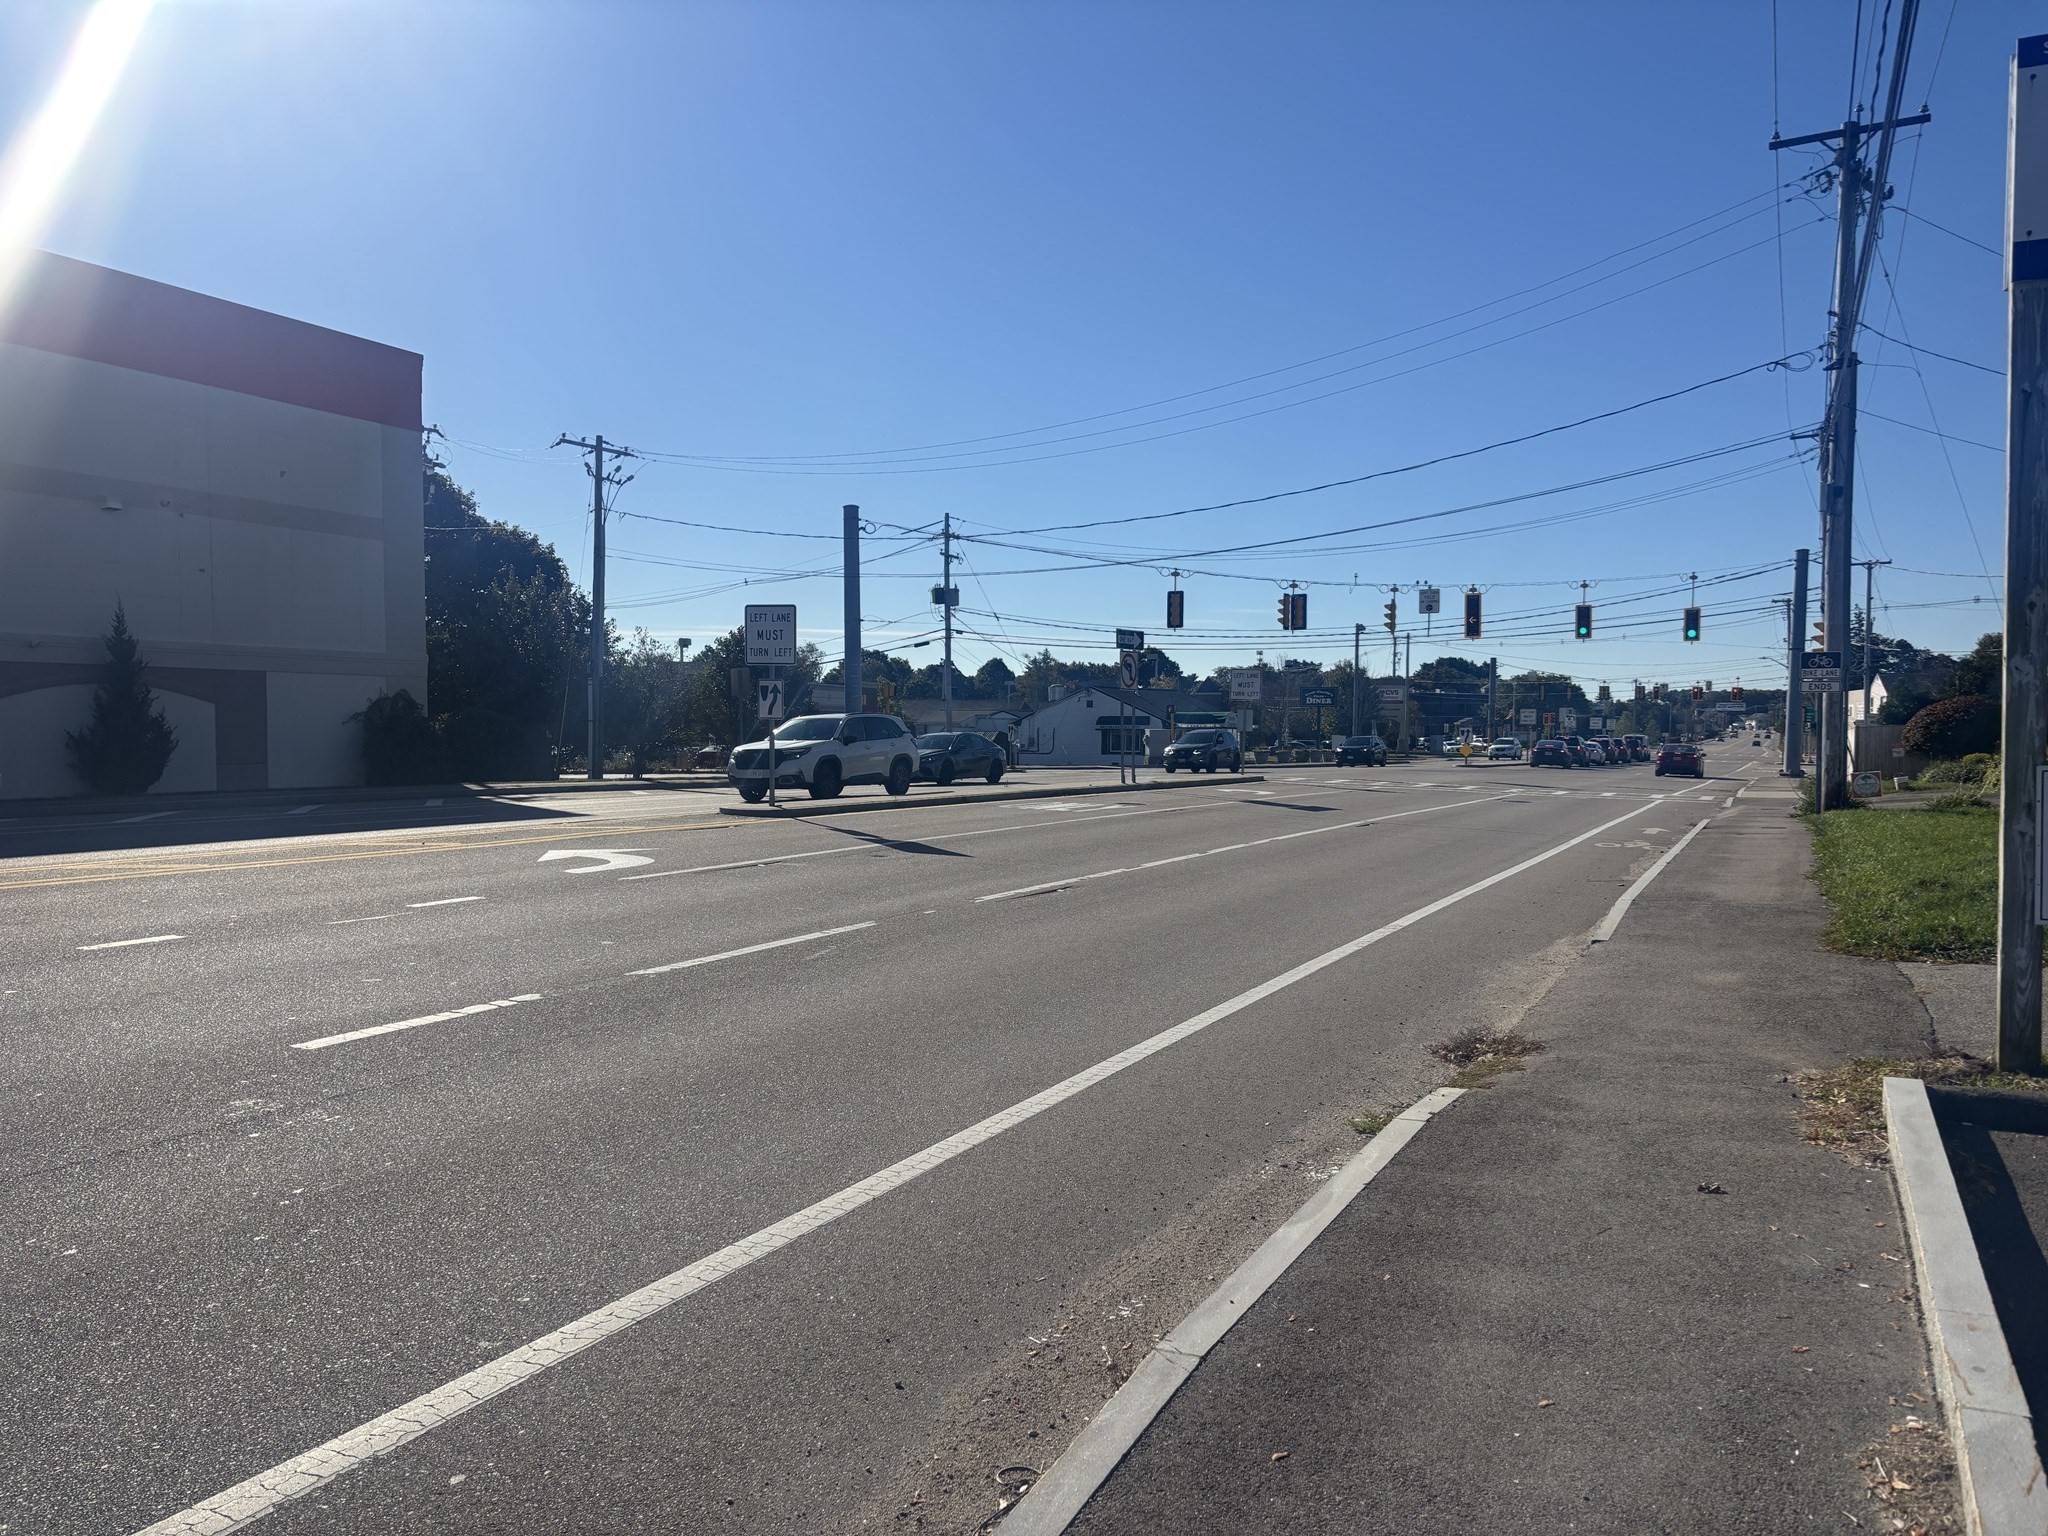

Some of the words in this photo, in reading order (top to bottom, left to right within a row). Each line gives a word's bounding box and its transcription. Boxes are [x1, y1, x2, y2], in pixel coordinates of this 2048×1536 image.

[749, 613, 768, 623] LEFT
[771, 613, 791, 623] LANE
[757, 629, 784, 641] MUST
[749, 647, 769, 657] TURN
[774, 647, 792, 657] LEFT
[1802, 668, 1818, 678] BIKE
[1820, 668, 1839, 678] LANE
[1237, 681, 1254, 689] MUST
[1808, 682, 1832, 691] ENDS
